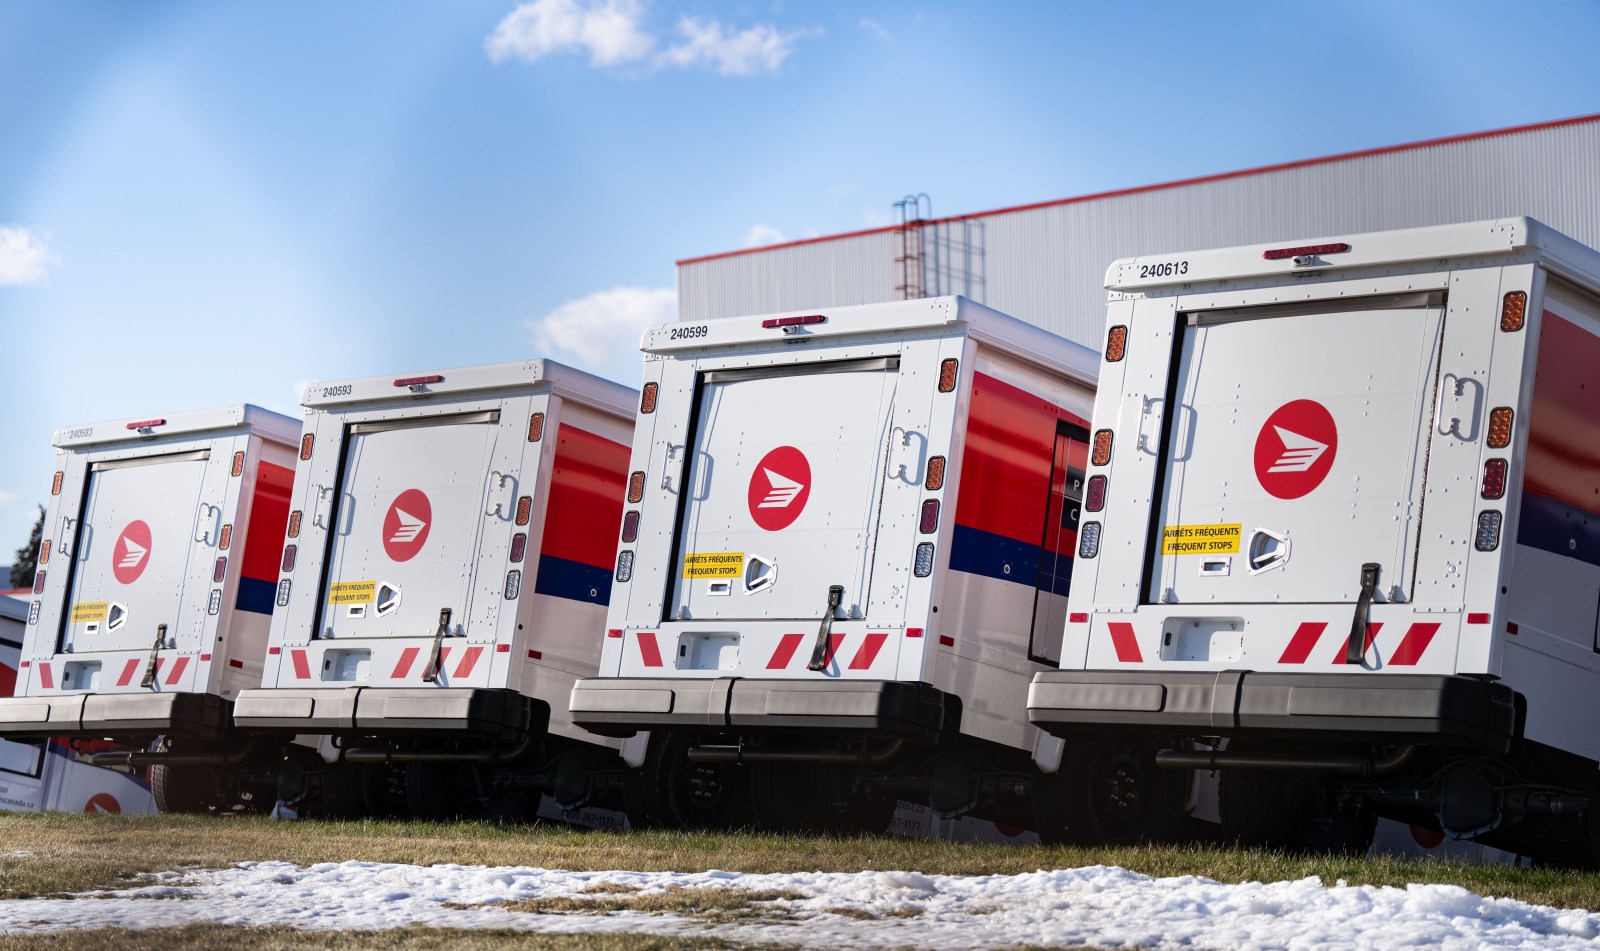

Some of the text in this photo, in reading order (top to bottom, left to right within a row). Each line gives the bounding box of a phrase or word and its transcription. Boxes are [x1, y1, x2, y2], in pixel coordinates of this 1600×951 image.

[1140, 261, 1189, 278] 240613
[670, 325, 708, 340] 240599
[322, 384, 353, 398] 240593
[69, 427, 93, 439] 240583
[1163, 527, 1240, 538] ARRÊTS FRÉQUENTS
[1167, 541, 1233, 552] FREQUENT STOPS
[708, 554, 743, 564] FRÉQUENTS
[687, 567, 737, 576] FREQUENT STOPS
[331, 593, 371, 602] FREQUENT STOPS
[896, 801, 925, 814] post.ca
